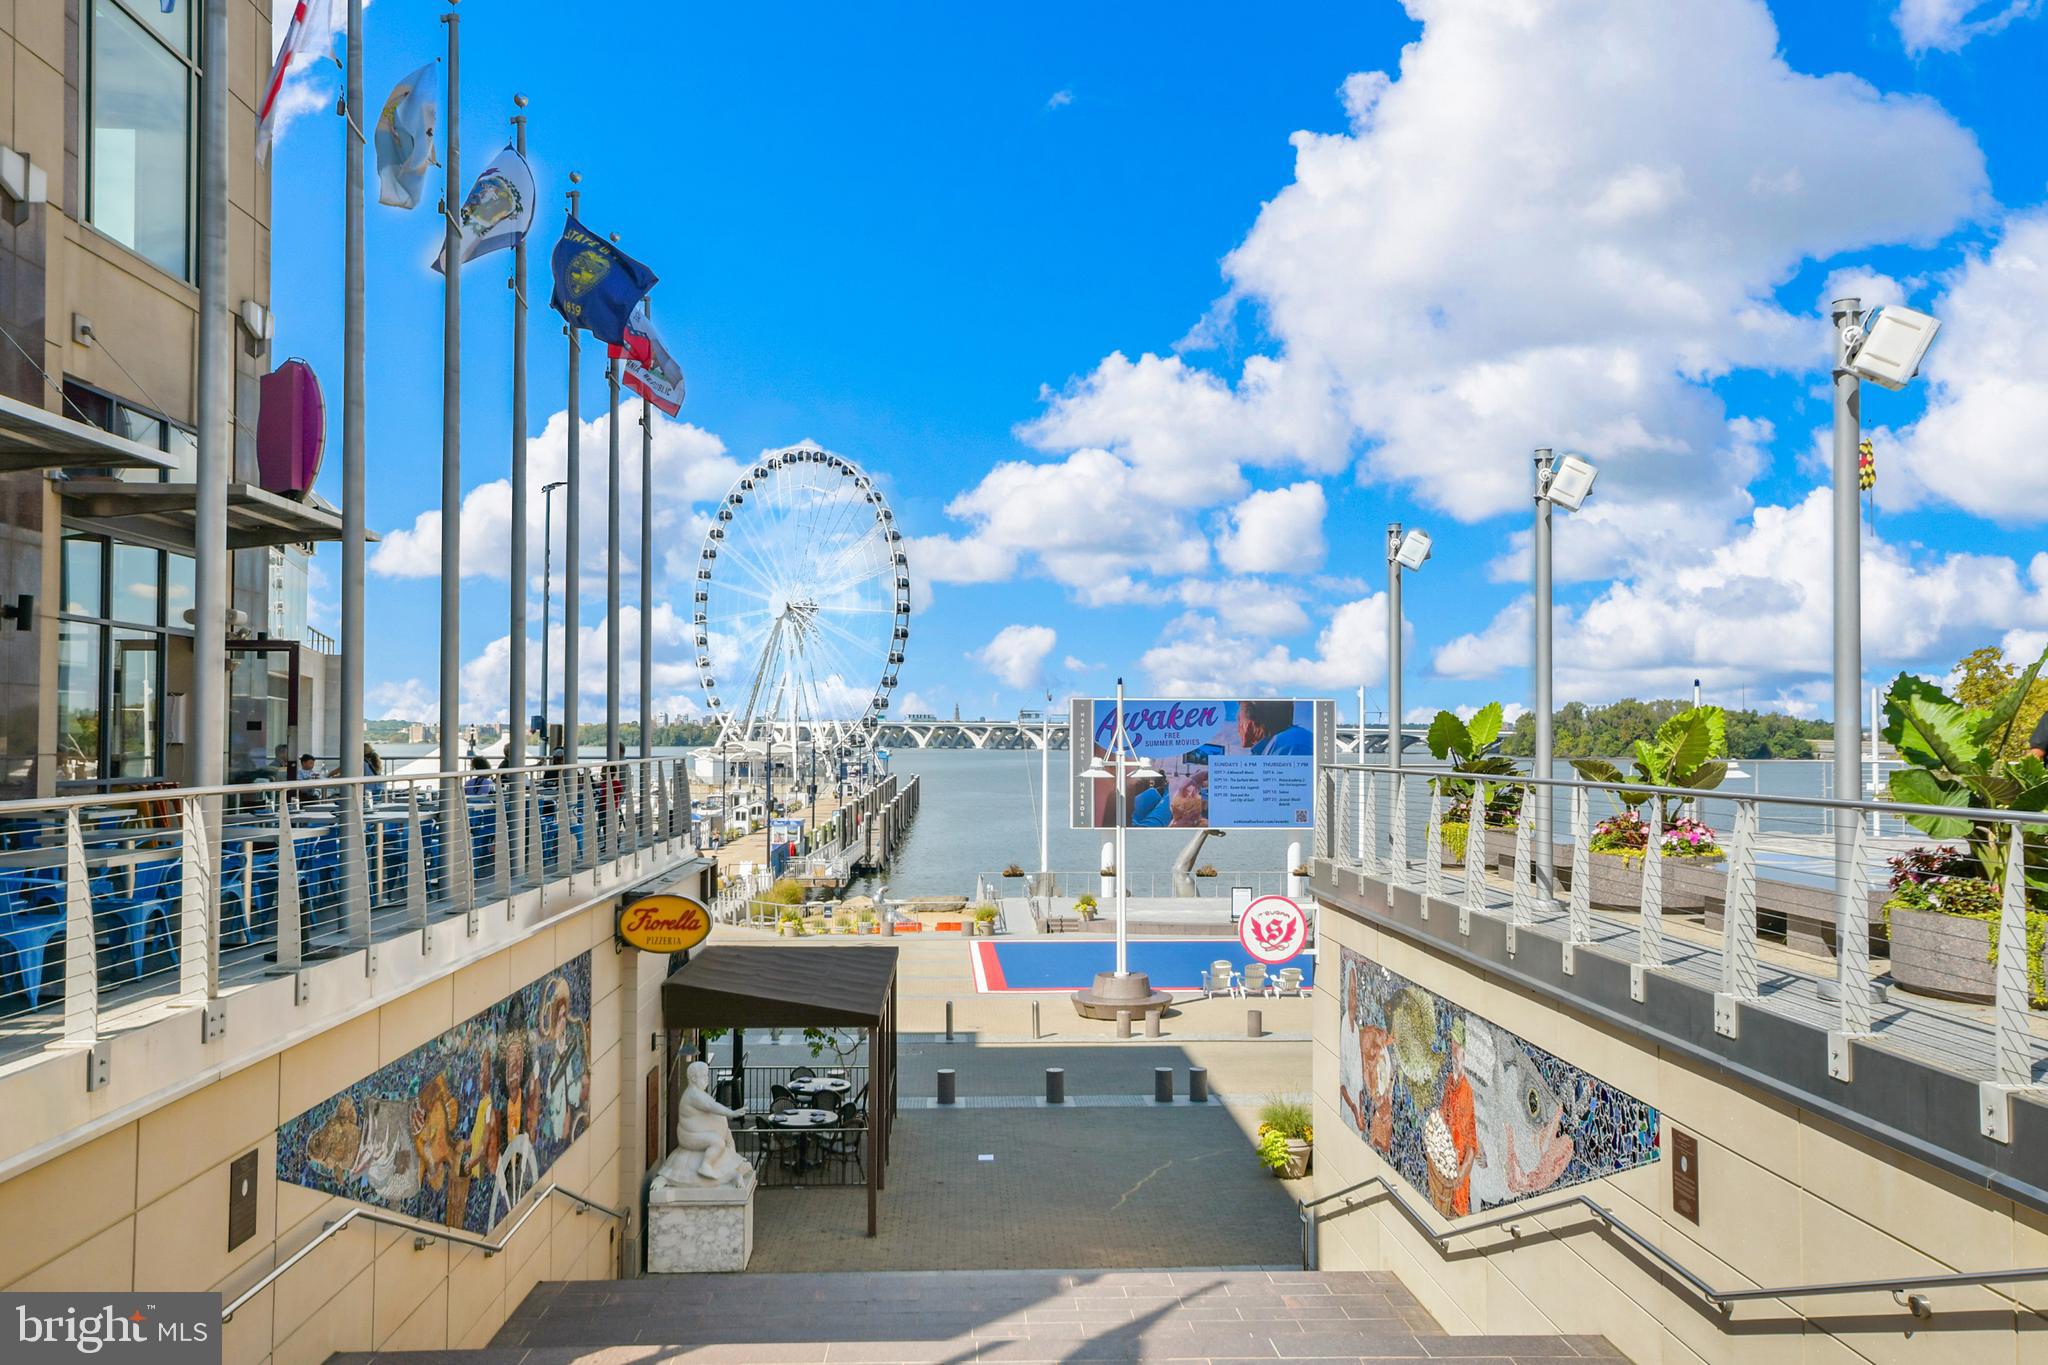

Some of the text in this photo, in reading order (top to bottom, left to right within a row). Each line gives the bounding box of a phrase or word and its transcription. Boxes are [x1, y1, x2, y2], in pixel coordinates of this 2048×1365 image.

[564, 228, 600, 248] STATE
[563, 299, 582, 316] 1859
[1095, 701, 1219, 751] Awaken
[627, 907, 702, 932] Fiorella
[646, 936, 682, 945] PIZZERIA
